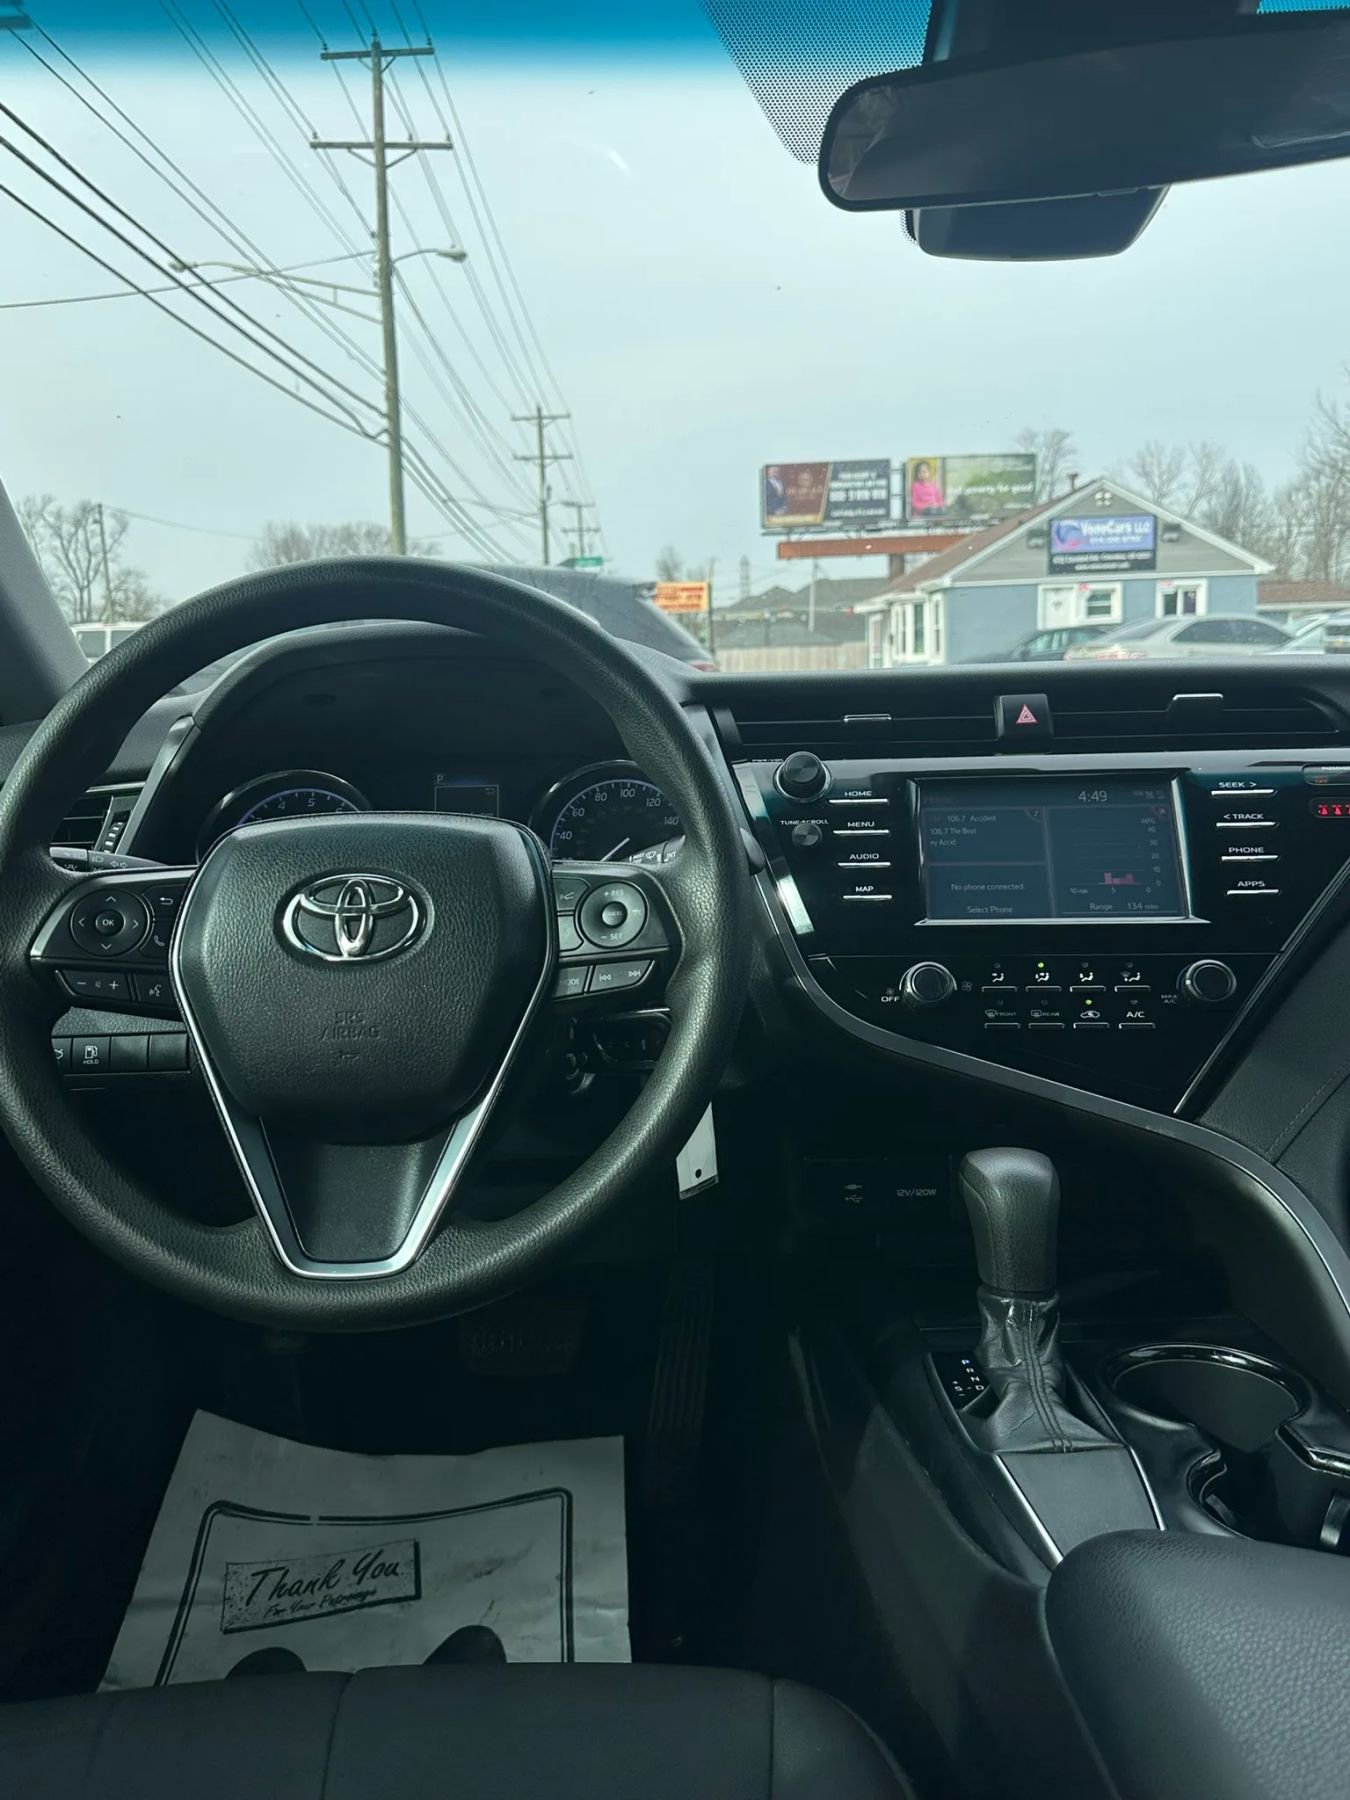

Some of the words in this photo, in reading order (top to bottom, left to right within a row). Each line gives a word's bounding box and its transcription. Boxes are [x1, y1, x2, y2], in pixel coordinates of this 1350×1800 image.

[595, 792, 607, 802] 80
[620, 788, 636, 798] 100
[1078, 790, 1108, 802] 4:49
[278, 801, 286, 810] 4
[307, 799, 316, 808] 5
[646, 798, 661, 807] 120
[572, 807, 585, 817] 60
[664, 816, 679, 825] 140
[560, 831, 572, 840] 40
[951, 883, 962, 891] No
[963, 882, 985, 893] phone
[967, 905, 988, 915] Select
[989, 905, 1014, 914] Phone
[1090, 902, 1113, 912] Range
[1127, 902, 1144, 911] 134
[101, 918, 116, 927] OK
[1126, 1010, 1146, 1018] A/C
[246, 1558, 346, 1607] Thank
[352, 1549, 399, 1586] You
